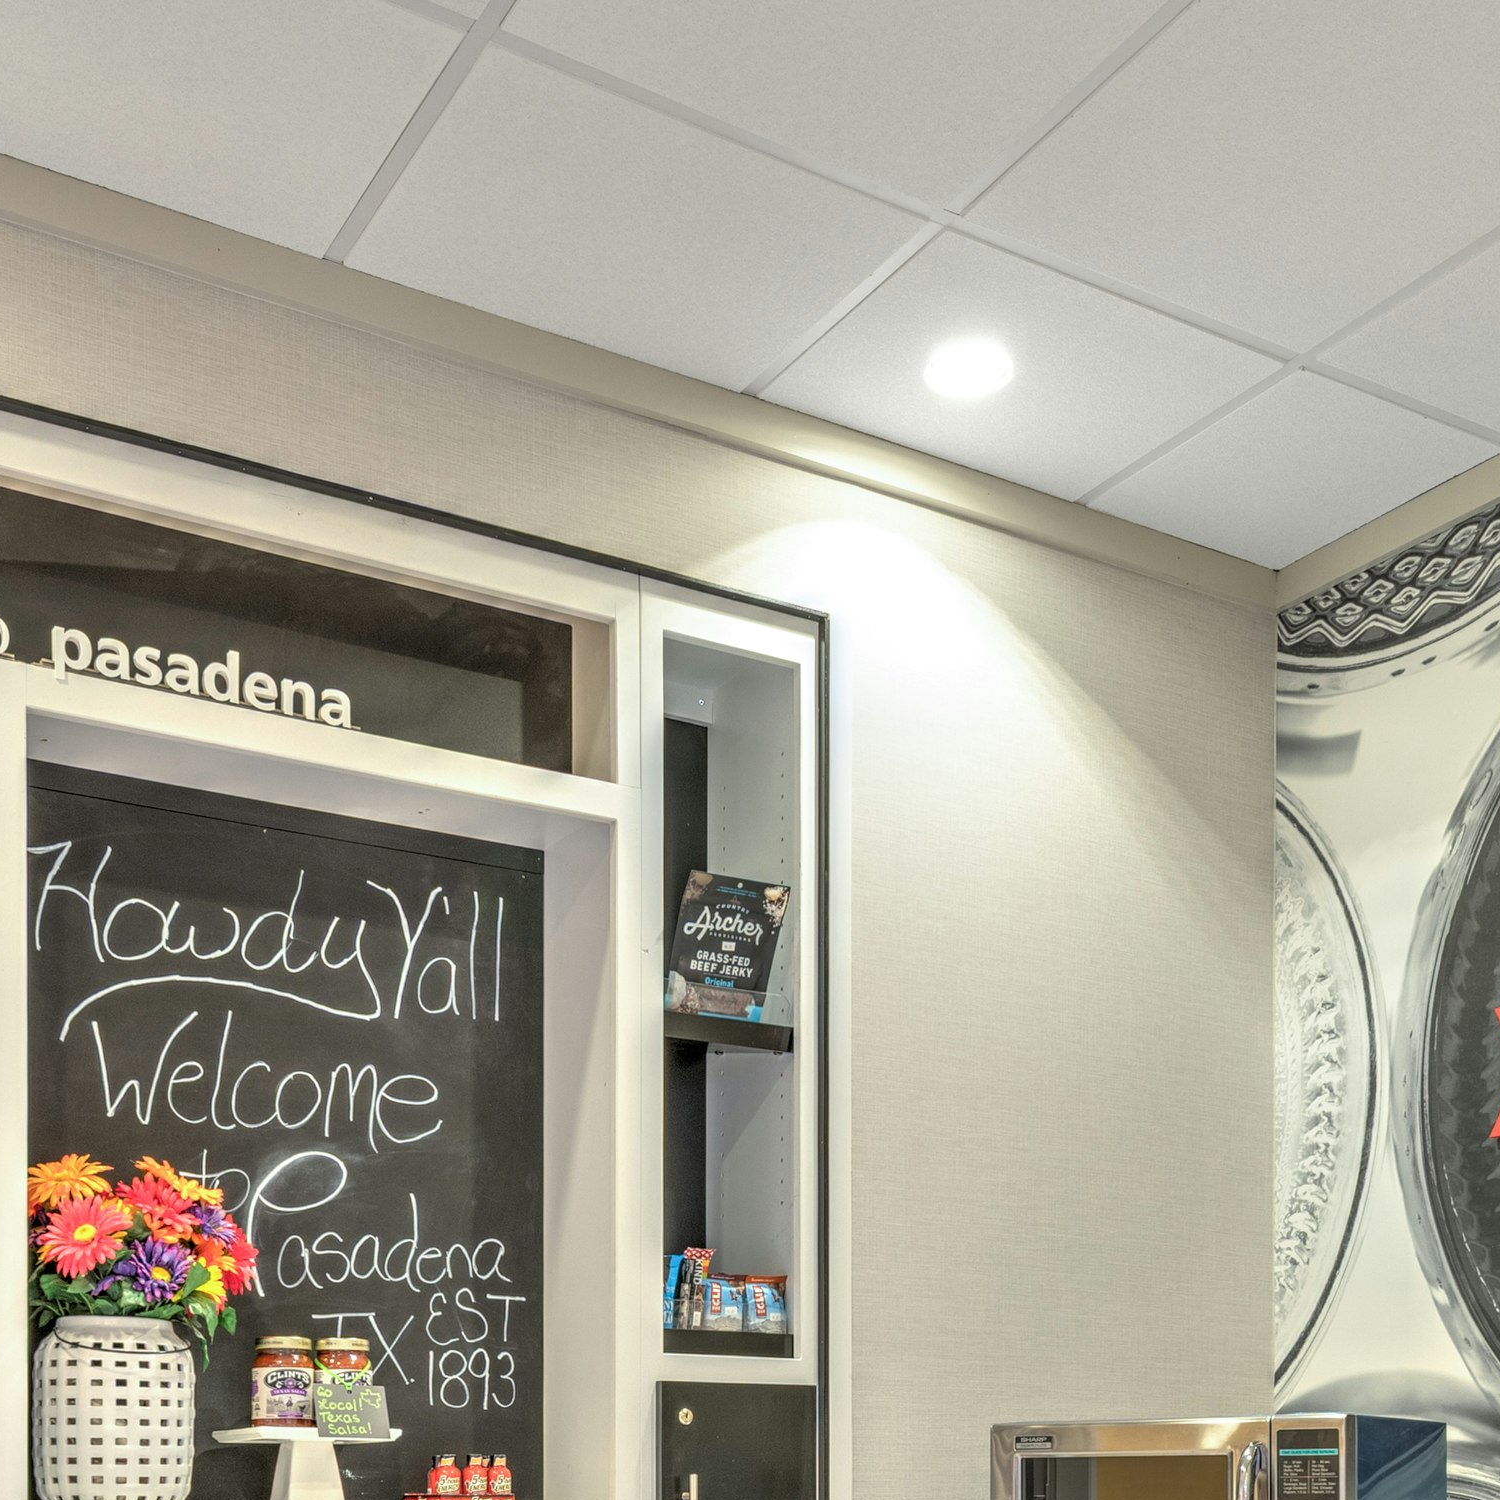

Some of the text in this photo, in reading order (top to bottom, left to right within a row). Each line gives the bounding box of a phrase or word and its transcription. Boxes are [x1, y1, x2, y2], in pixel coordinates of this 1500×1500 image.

[52, 624, 355, 730] pasadena
[684, 906, 763, 945] Archer
[716, 904, 750, 914] COUNTRY
[27, 841, 503, 1021] Howdy Y'all
[690, 960, 753, 978] BEEF JERKY
[705, 976, 735, 988] Original
[92, 1010, 443, 1152] Welcome
[178, 1149, 513, 1296] to Pasadena
[693, 1259, 704, 1285] KIND
[427, 1288, 525, 1343] EST
[429, 1349, 516, 1409] 1893
[319, 1412, 360, 1424] Texas
[328, 1422, 372, 1435] Salsa!
